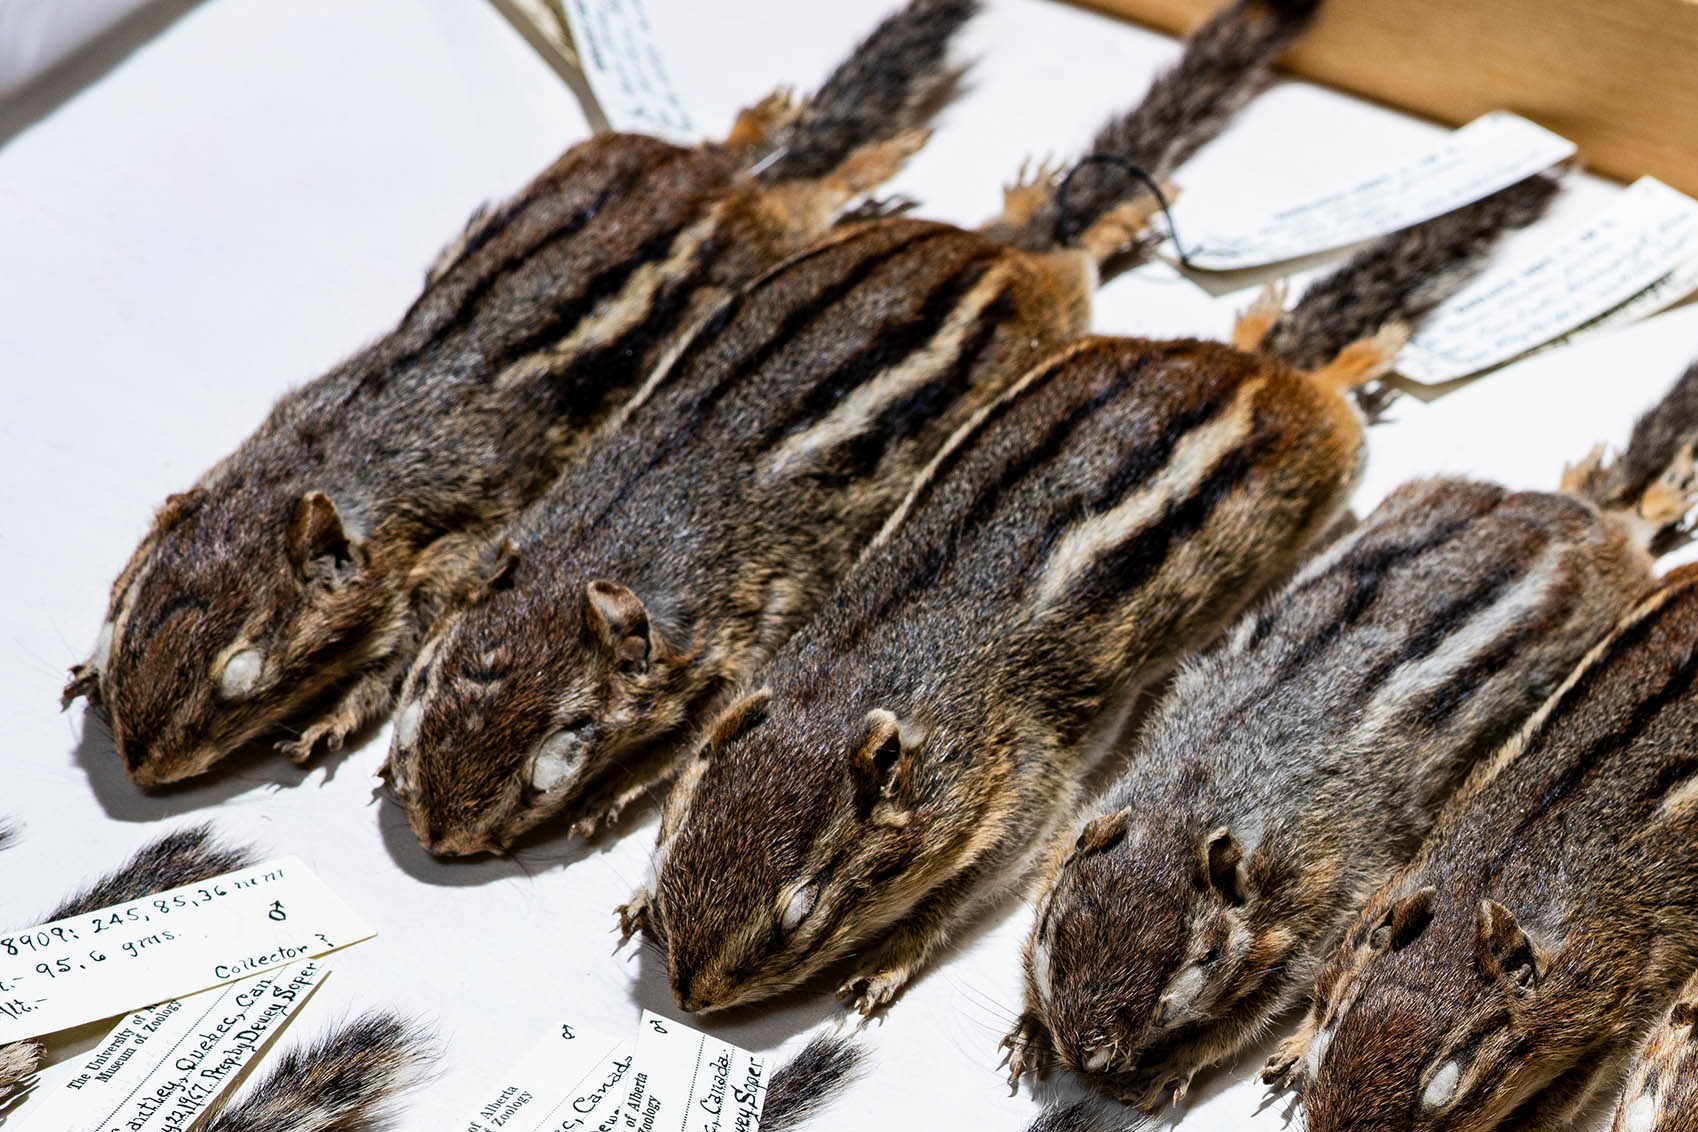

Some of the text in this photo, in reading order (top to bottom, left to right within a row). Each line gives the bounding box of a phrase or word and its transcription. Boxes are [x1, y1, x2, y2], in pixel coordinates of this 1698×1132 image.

[0, 927, 80, 956] 8909:
[215, 945, 309, 980] Collector
[272, 961, 319, 1002] Soper
[66, 1014, 147, 1090] The University of
[94, 999, 183, 1083] Museum of Zoology
[627, 1073, 648, 1112] Alberta
[700, 1049, 730, 1115] Canada.
[730, 1057, 768, 1109] Soper
[468, 1121, 481, 1132] of
[480, 1087, 518, 1119] Alberta
[491, 1091, 533, 1127] Zoology
[624, 1113, 637, 1128] of
